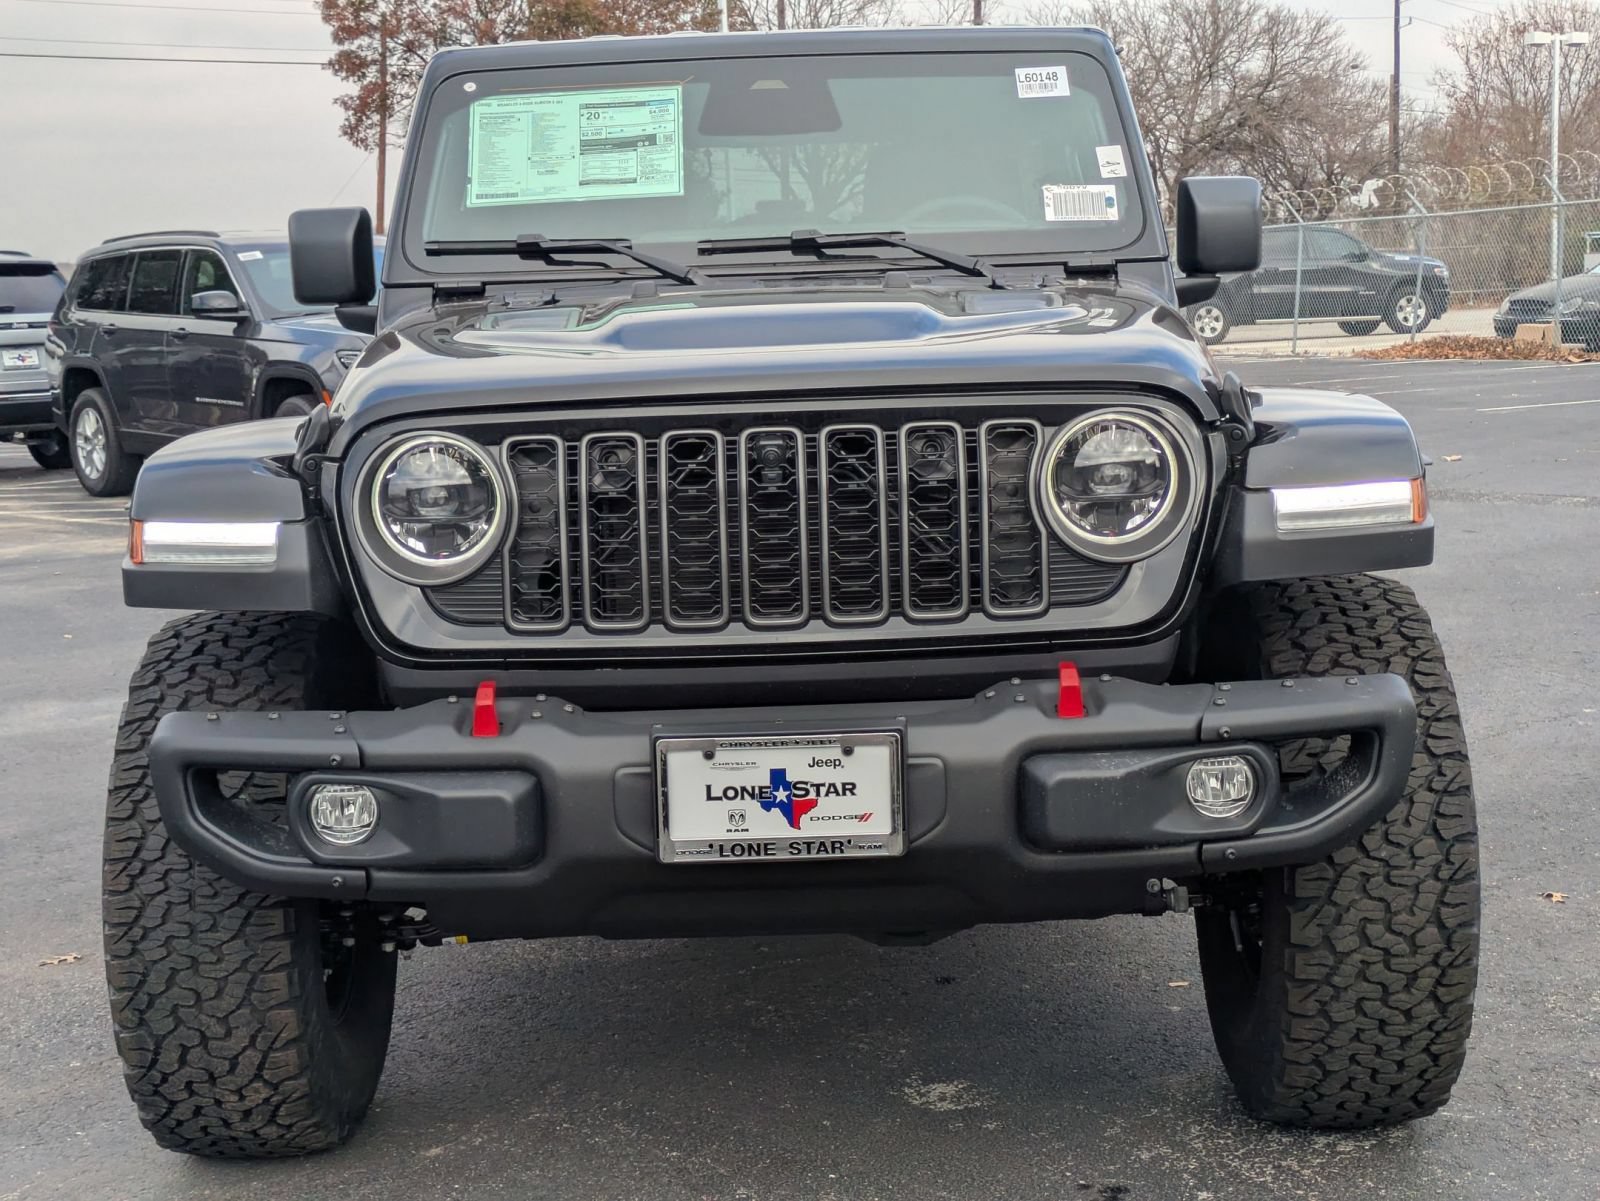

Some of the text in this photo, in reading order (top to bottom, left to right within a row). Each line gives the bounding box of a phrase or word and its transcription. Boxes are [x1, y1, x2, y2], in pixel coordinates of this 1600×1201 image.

[1017, 71, 1059, 83] L60148
[586, 111, 600, 121] 20
[720, 740, 789, 748] CHRYSLER
[808, 756, 842, 769] Jeep
[705, 780, 857, 801] LONE STAR
[810, 814, 862, 822] DODGE
[719, 840, 845, 857] LONE STAR
